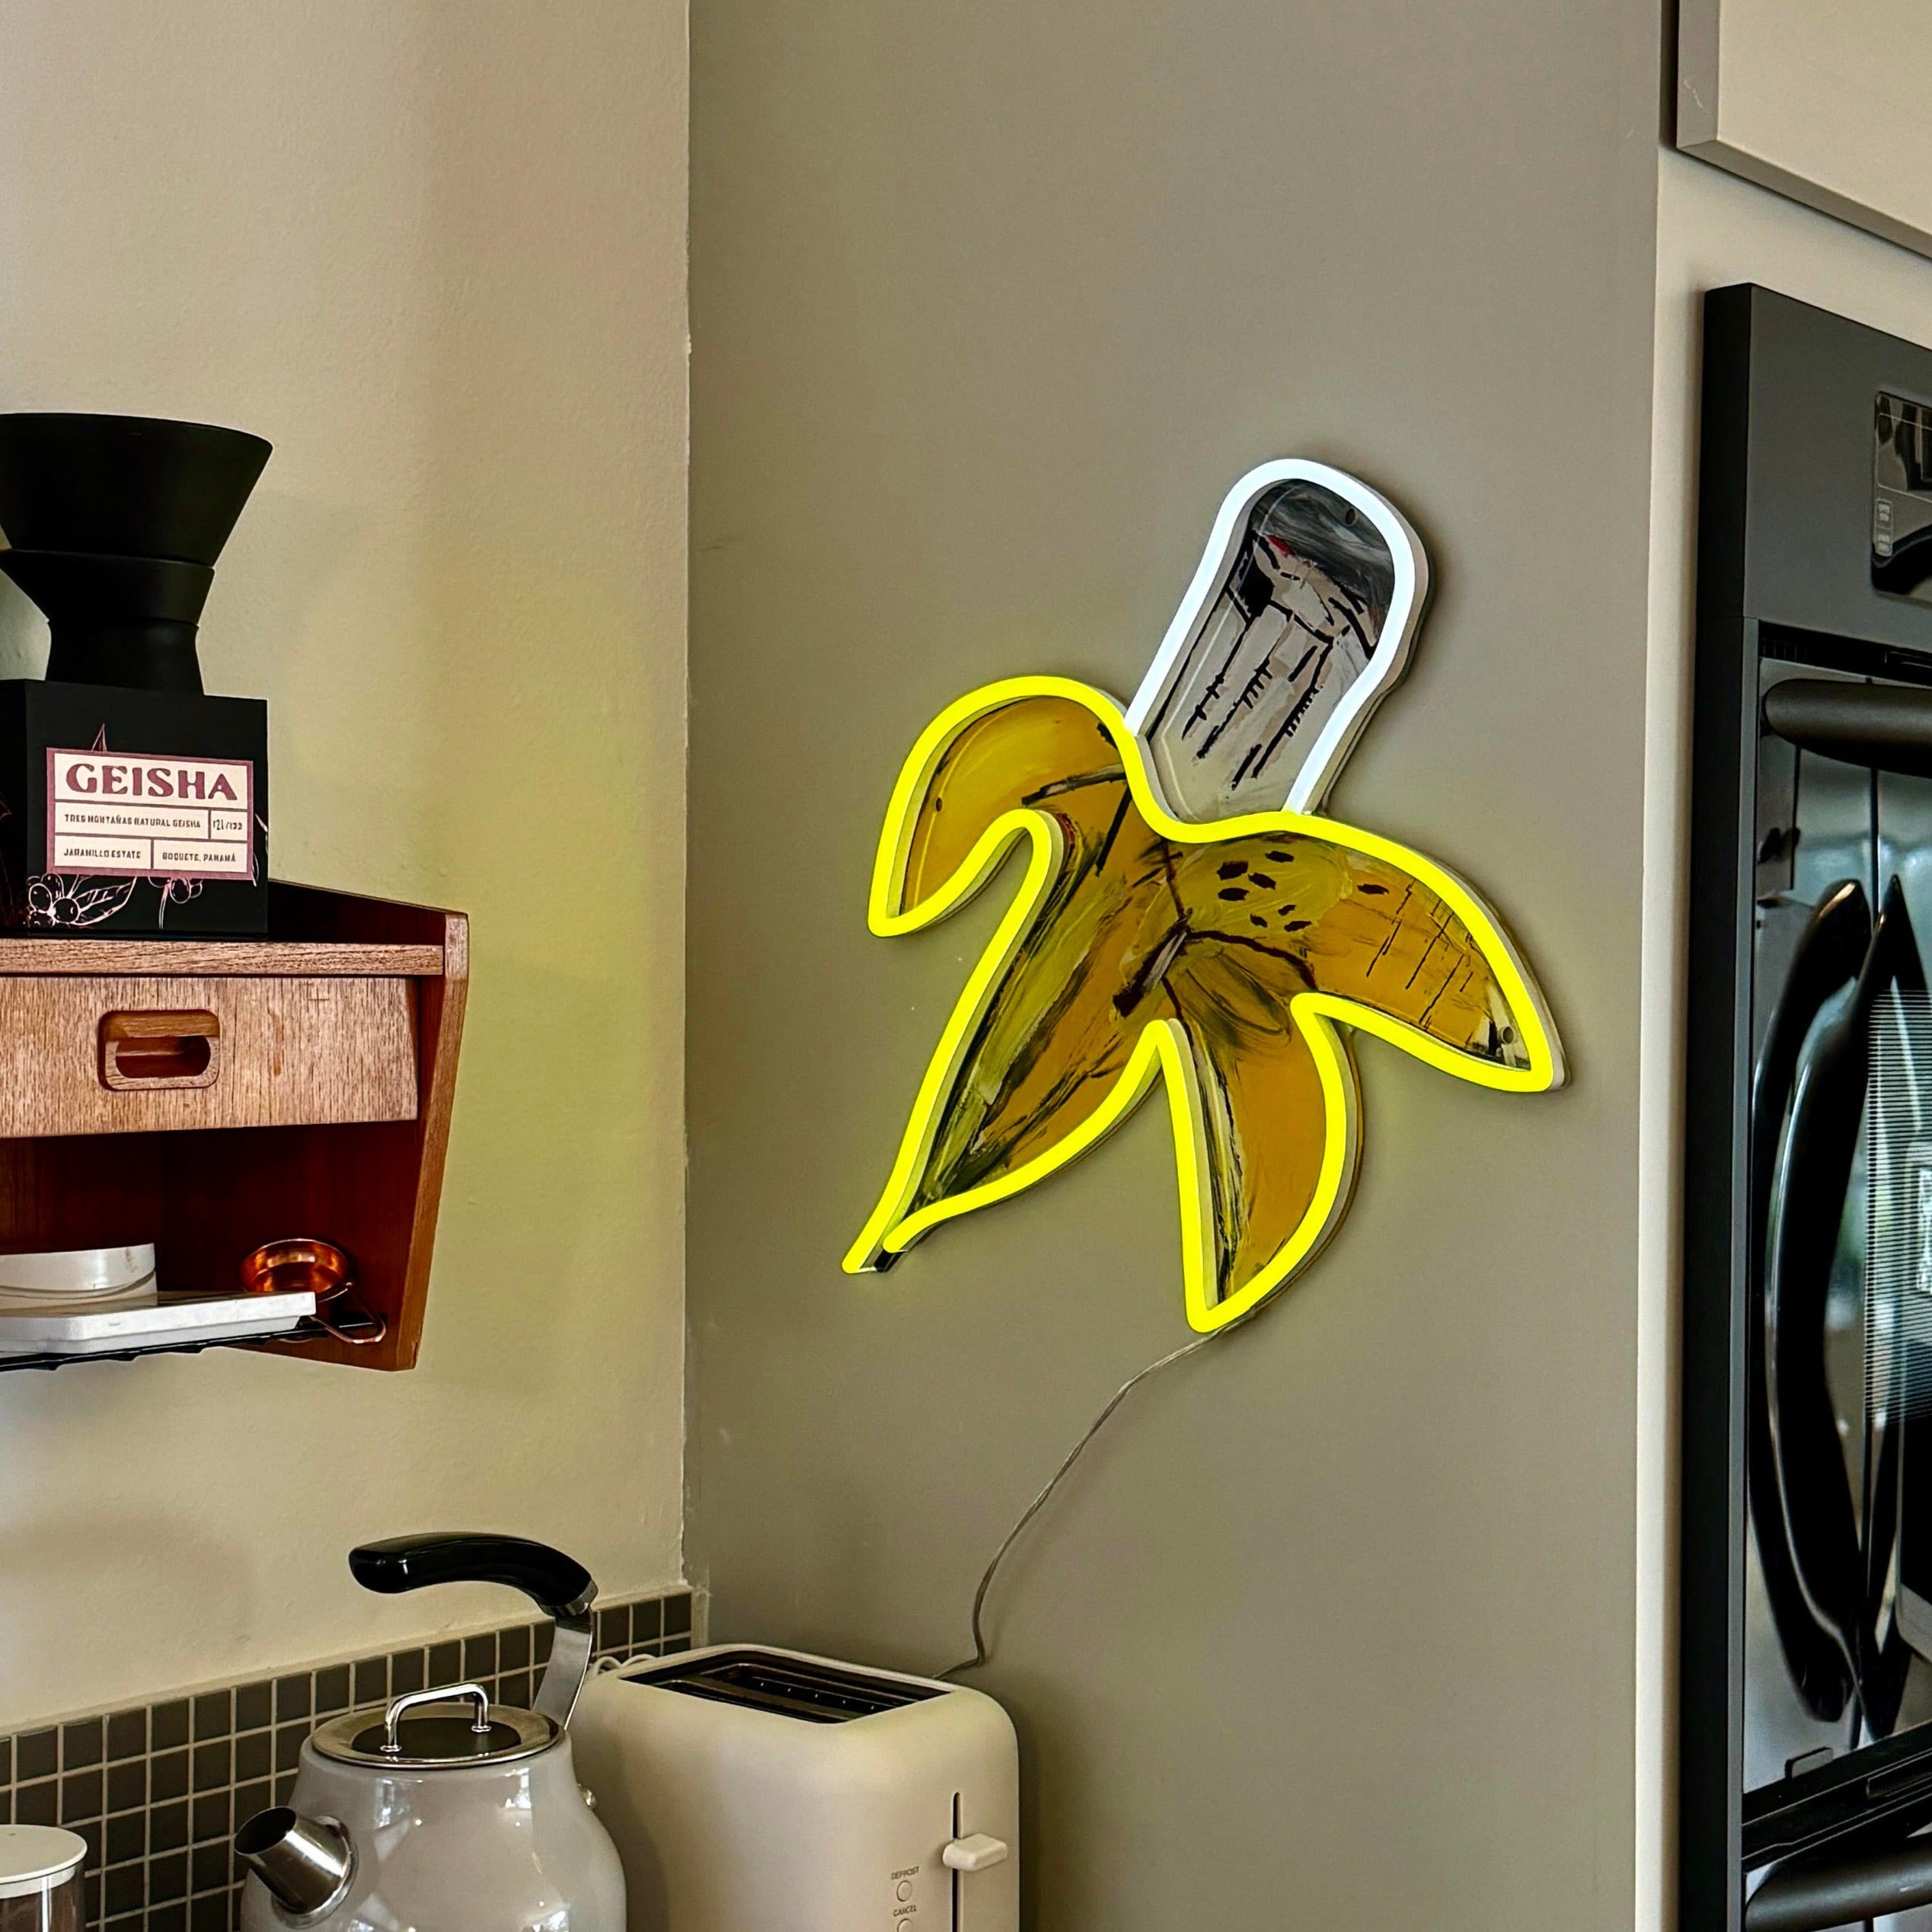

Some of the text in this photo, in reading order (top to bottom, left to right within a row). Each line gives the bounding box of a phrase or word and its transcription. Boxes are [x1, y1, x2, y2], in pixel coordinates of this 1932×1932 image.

[65, 763, 238, 800] GEISHA
[64, 813, 86, 823] TRES
[134, 817, 171, 827] NATURAL
[172, 819, 201, 828] GEISHA
[63, 848, 142, 859] JARAMILLO ESTATE
[890, 1866, 919, 1880] DEFROST
[893, 1905, 917, 1918] CANCEL
